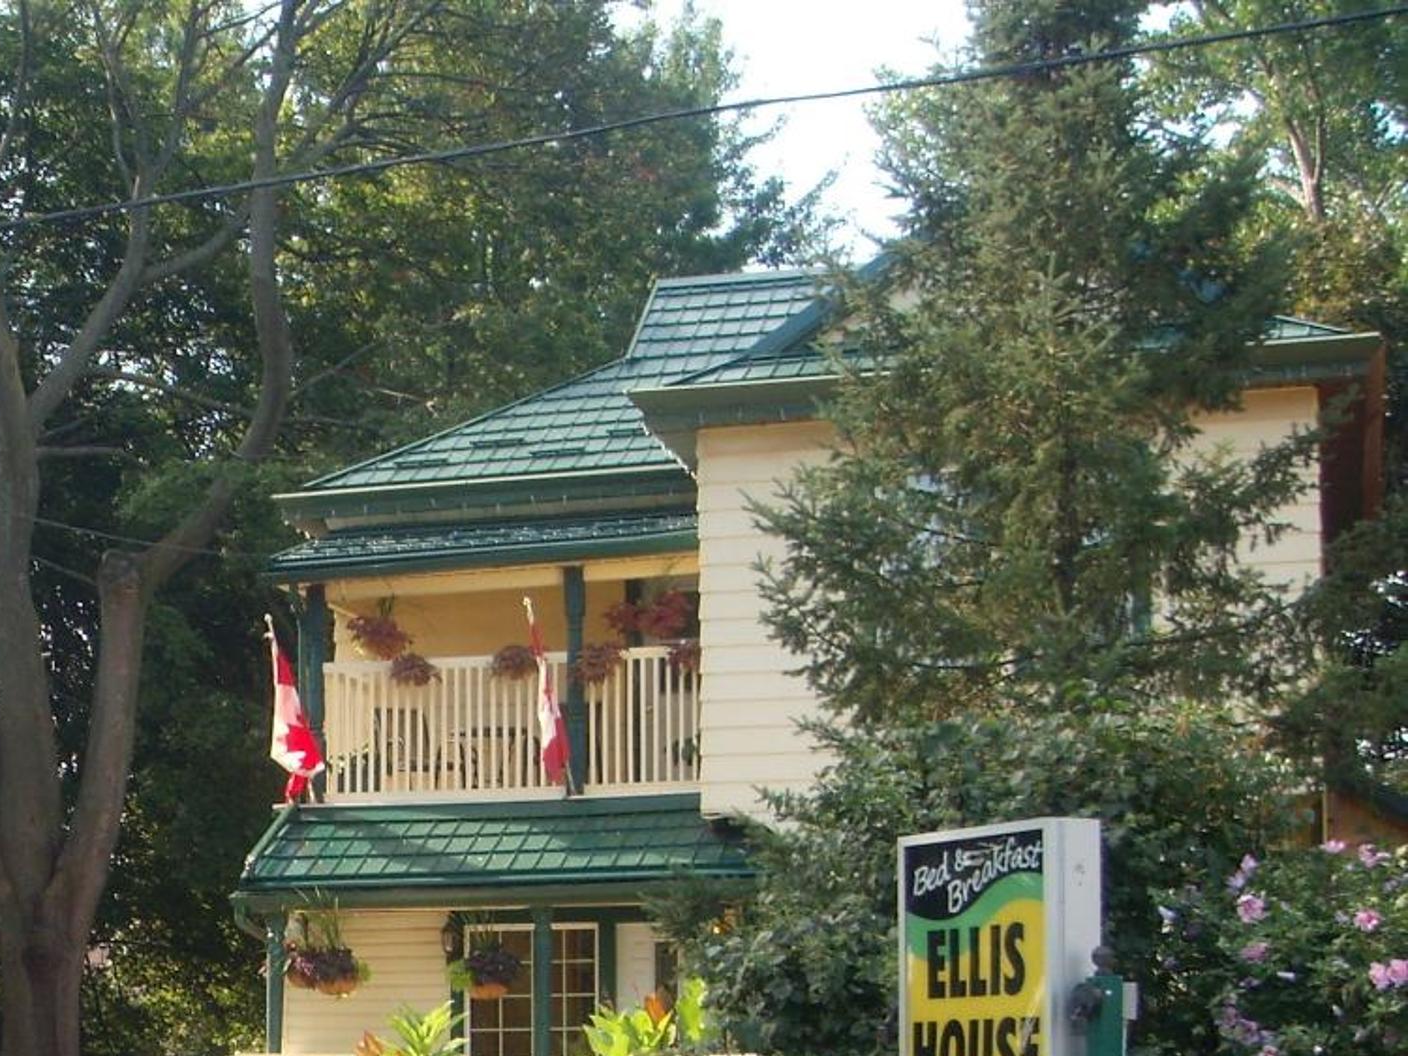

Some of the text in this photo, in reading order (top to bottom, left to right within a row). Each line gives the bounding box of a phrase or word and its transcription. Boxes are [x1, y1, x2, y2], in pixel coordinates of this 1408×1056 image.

[913, 851, 950, 896] Bed
[947, 837, 1043, 913] Breakfast
[927, 922, 1026, 999] ELLIS
